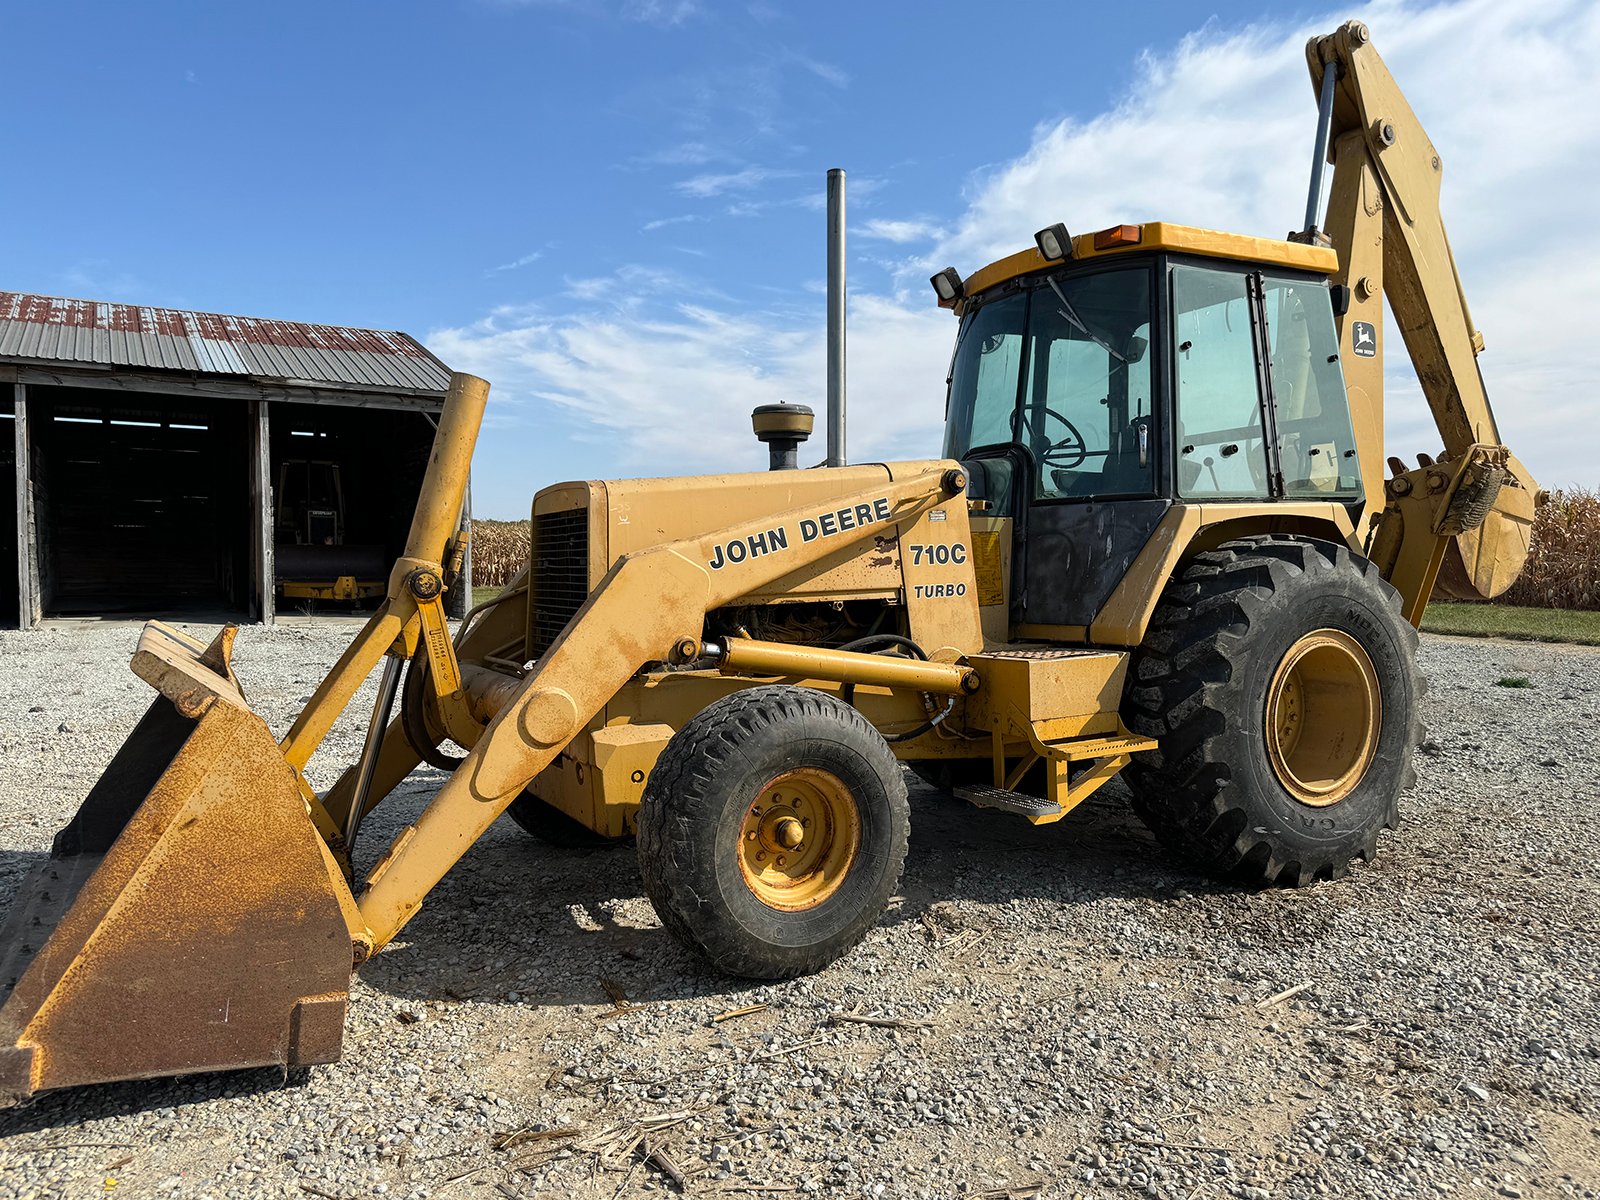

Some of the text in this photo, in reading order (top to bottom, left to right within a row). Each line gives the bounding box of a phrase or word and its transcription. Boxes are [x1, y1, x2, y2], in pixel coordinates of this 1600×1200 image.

[709, 497, 892, 569] JOHN DEERE
[910, 543, 966, 565] 710C
[914, 583, 966, 599] TURBO
